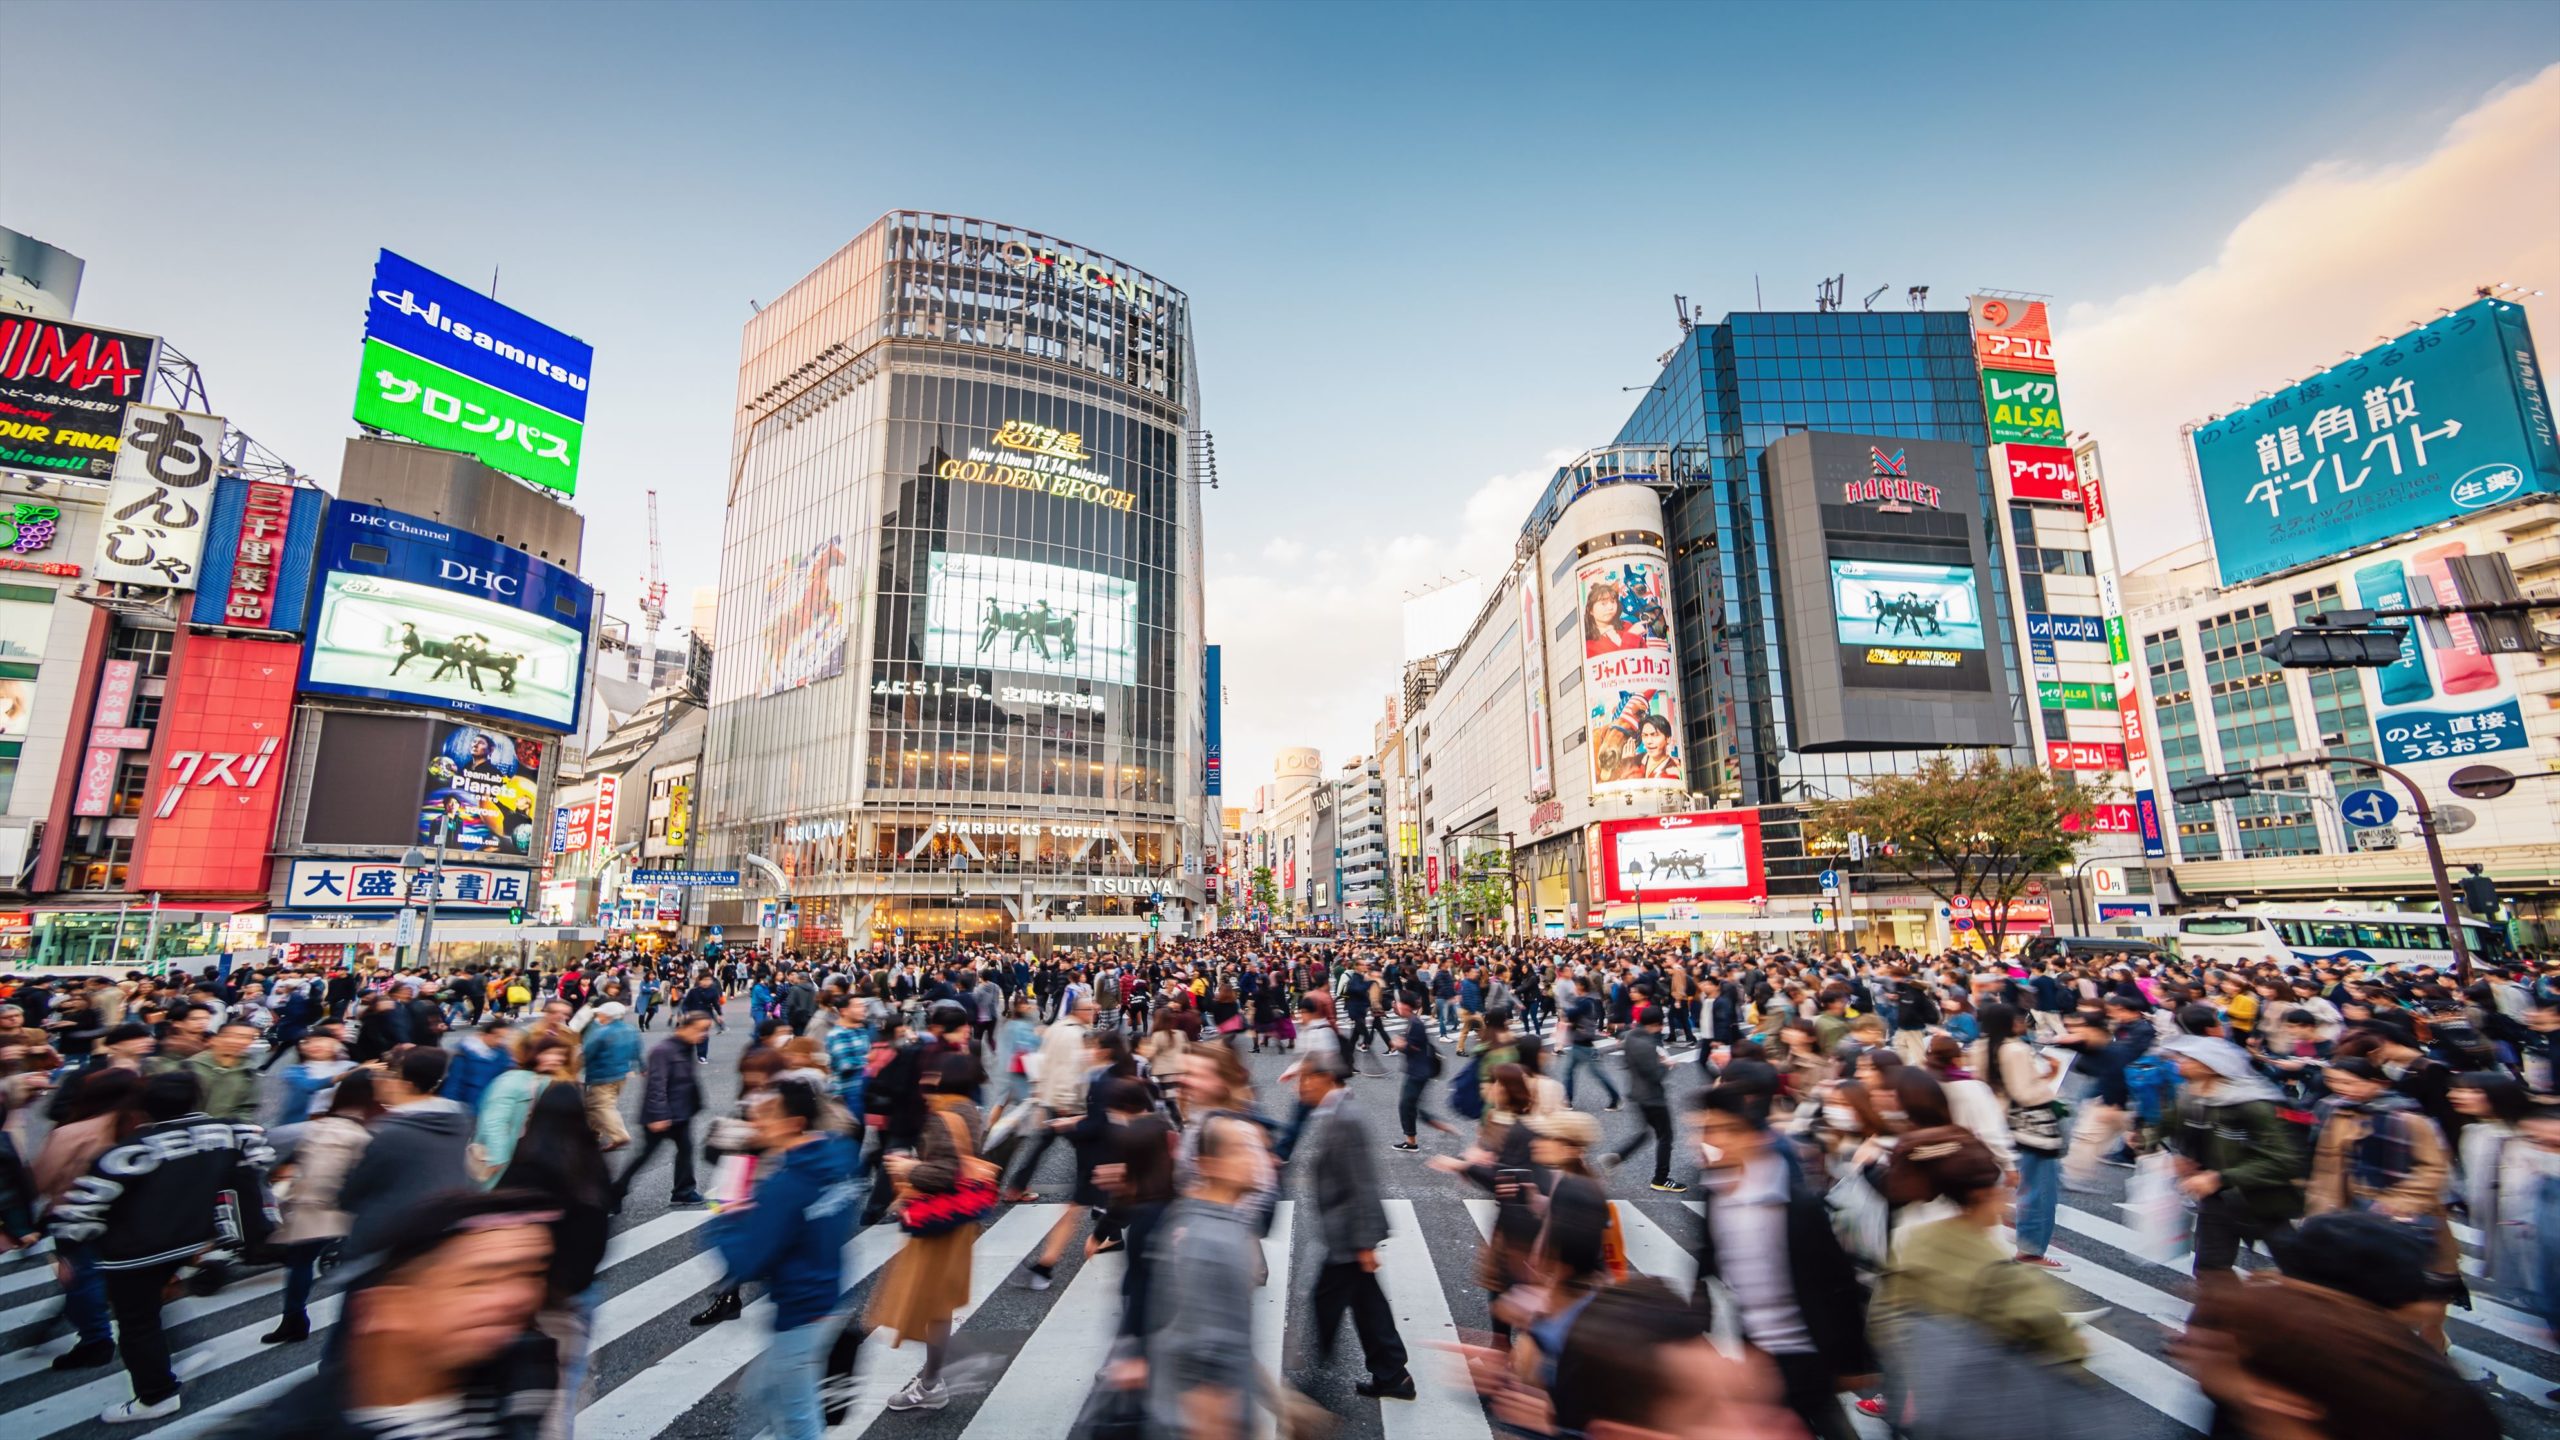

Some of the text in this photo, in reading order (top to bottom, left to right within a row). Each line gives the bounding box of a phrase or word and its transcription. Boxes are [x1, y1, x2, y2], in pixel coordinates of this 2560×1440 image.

[377, 289, 586, 391] Hisamitsu
[1988, 334, 2054, 361] アコム
[1990, 378, 2055, 405] レイク
[376, 369, 571, 467] サロンパス
[1994, 404, 2062, 429] ALSA
[2255, 377, 2421, 475] 龍角散
[0, 446, 88, 471] elease!!
[969, 447, 1111, 485] New Album 11.14 Release
[2010, 460, 2075, 482] アイフル
[2245, 420, 2440, 518] ダイレクト
[940, 459, 1137, 513] GOLDEN EPOCH
[1845, 477, 1941, 510] MAGNET
[2061, 489, 2079, 501] 8F
[2456, 465, 2517, 501] 生薬
[106, 412, 213, 585] もんじゃ
[350, 513, 450, 543] DHC Channel
[438, 559, 518, 597] DHC
[1592, 655, 1671, 681] ジャパンカップ
[451, 700, 476, 711] DHC
[2064, 689, 2088, 699] ALSA
[2386, 711, 2519, 743] のど、直接、
[2054, 748, 2103, 765] アコム
[2402, 733, 2501, 762] うるおう
[154, 736, 281, 818] クスリ
[463, 769, 503, 783] teamLab
[1207, 744, 1221, 786] SEIBU
[452, 775, 517, 799] Planets
[936, 821, 1109, 839] STARBUCKS COFFEE
[1659, 816, 1693, 829] Glico
[303, 868, 521, 901] 大盛堂書店
[1091, 878, 1174, 894] TSUTAYA
